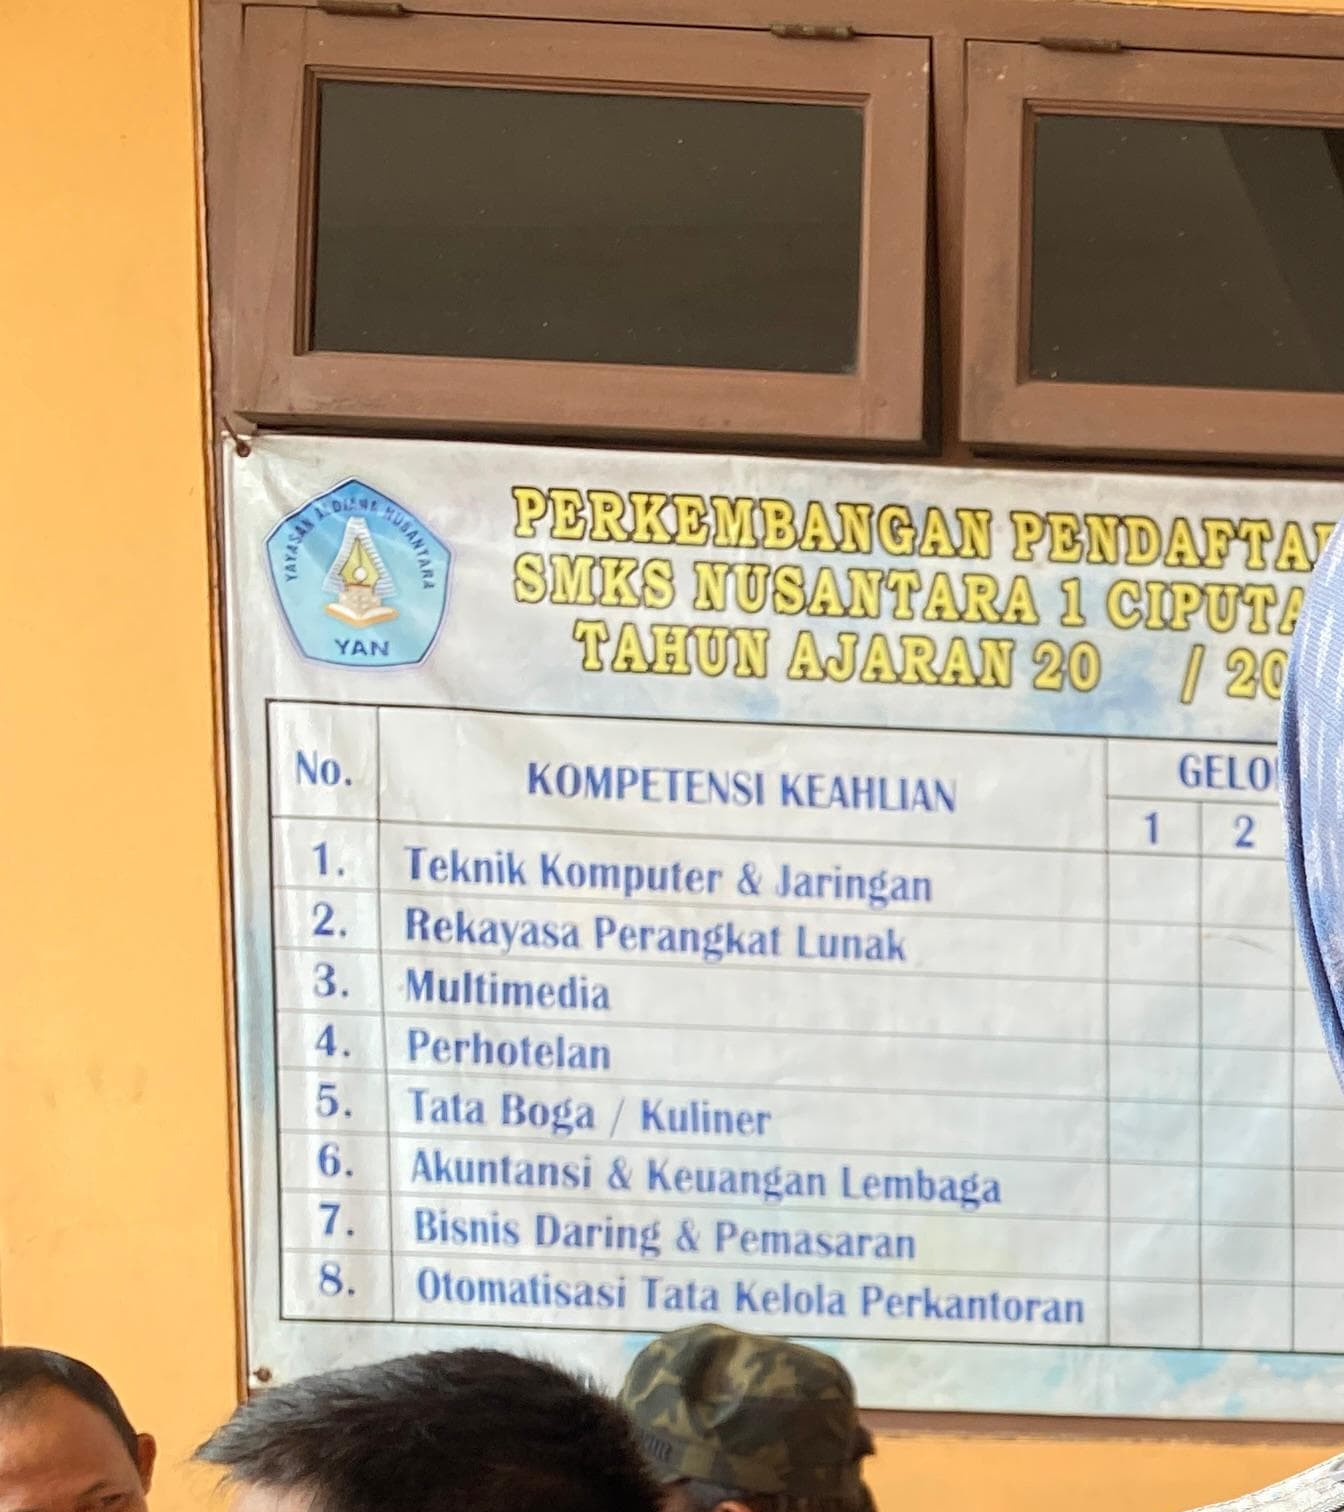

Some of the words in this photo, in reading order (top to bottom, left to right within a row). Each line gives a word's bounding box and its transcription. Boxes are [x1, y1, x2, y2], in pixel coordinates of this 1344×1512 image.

[284, 519, 315, 582] YAYASAN
[511, 486, 992, 559] PERKEMBANGAN
[513, 552, 676, 611] SMKS
[693, 560, 1040, 627] NUSANTARA
[1059, 577, 1087, 627] 1
[334, 639, 391, 656] YAN
[573, 620, 769, 680] TAHUN
[787, 630, 1015, 690] AJARAN
[1032, 640, 1103, 693] 20
[1180, 644, 1205, 705] /
[1225, 648, 1289, 701] 20
[295, 749, 354, 789] No.
[526, 761, 766, 808] KOMPETENSI
[779, 771, 957, 814] KEAHLIAN
[1178, 753, 1280, 792] GELO
[1144, 812, 1161, 847] 1
[1233, 814, 1257, 850] 2
[312, 842, 345, 877] 1.
[404, 845, 527, 886] Teknik
[540, 852, 724, 898] Komputer
[736, 863, 762, 896] &
[775, 864, 933, 909] Jaringan
[312, 903, 348, 938] 2.
[405, 906, 580, 955] Rekayasa
[593, 916, 782, 964] Perangkat
[796, 925, 907, 963] Lunak
[312, 963, 350, 999] 3.
[405, 967, 611, 1011] Multimedia
[314, 1024, 352, 1059] 4.
[407, 1027, 612, 1071] Perhotelan
[315, 1083, 353, 1120] 5.
[407, 1088, 486, 1126] Tata
[500, 1092, 595, 1135] Boga
[609, 1098, 625, 1139] /
[639, 1099, 772, 1136] Kuliner
[317, 1144, 354, 1180] 6.
[410, 1149, 593, 1190] Akuntansi
[607, 1156, 633, 1191] &
[646, 1159, 827, 1202] Keuangan
[841, 1166, 1001, 1211] Lembaga
[318, 1203, 355, 1237] 7.
[414, 1209, 521, 1249] Bisnis
[534, 1215, 661, 1258] Daring
[675, 1218, 703, 1253] &
[715, 1219, 917, 1261] Pemasaran
[318, 1262, 356, 1298] 8.
[416, 1266, 628, 1309] Otomatisasi
[643, 1278, 719, 1313] Tata
[734, 1281, 846, 1318] Kelola
[860, 1282, 1086, 1325] Perkantoran
